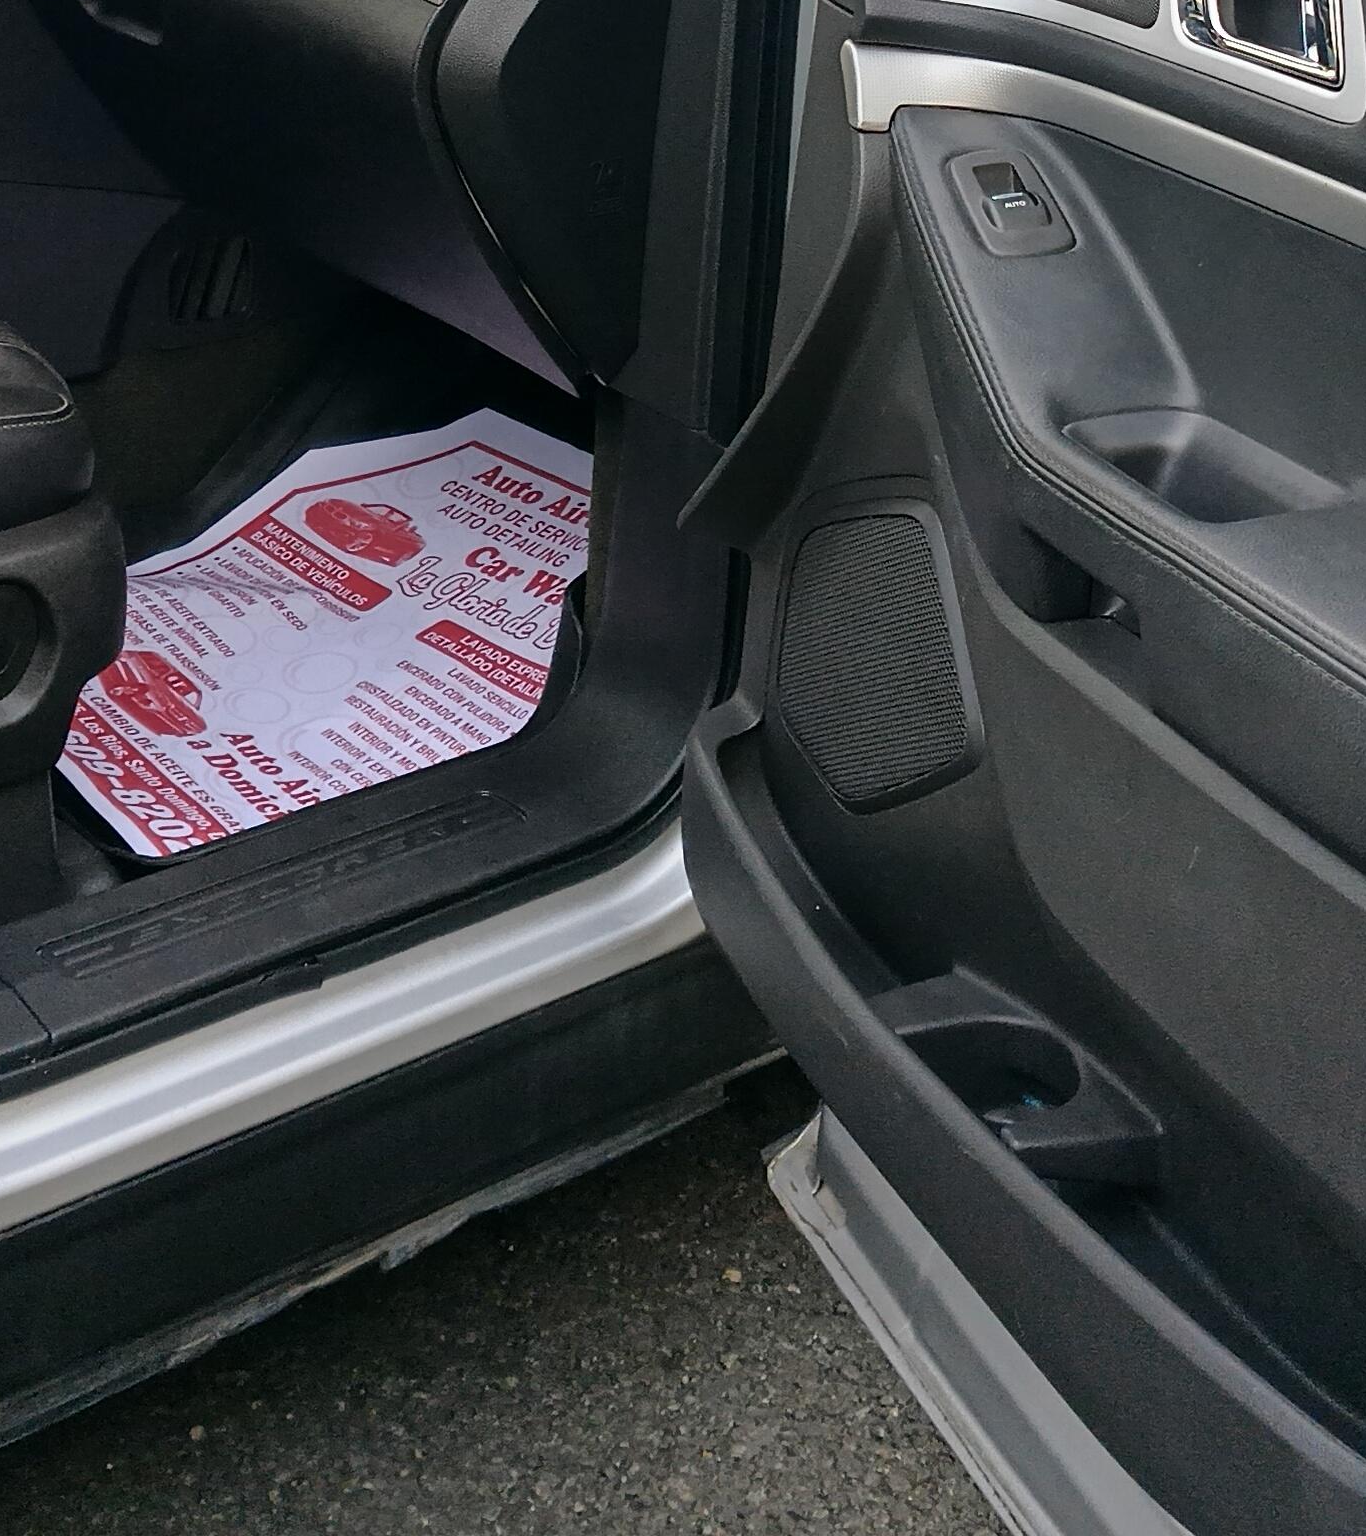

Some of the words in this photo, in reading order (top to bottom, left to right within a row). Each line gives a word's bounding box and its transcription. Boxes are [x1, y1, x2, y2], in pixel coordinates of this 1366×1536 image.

[440, 480, 507, 515] CENTRO
[502, 509, 533, 528] DE
[472, 465, 544, 505] Auto
[262, 522, 350, 580] MANTENIMIENTO
[437, 503, 487, 530] AUTO
[482, 524, 570, 568] DETAILING
[289, 556, 310, 572] DE
[306, 566, 369, 606] VEHÍCULOS
[465, 546, 525, 583] Car
[165, 598, 199, 622] ACEITE
[208, 590, 246, 618] GRAFITO
[270, 598, 288, 611] EN
[282, 610, 308, 631] SECO
[395, 556, 443, 598] La
[423, 572, 511, 628] Gloria
[501, 604, 548, 640] de
[126, 609, 158, 634] GRASA
[152, 633, 170, 645] DE
[135, 593, 153, 604] DE
[145, 604, 179, 628] ACEITE
[171, 627, 210, 659] NORMAL
[423, 631, 493, 672] DETALLADO
[460, 634, 510, 664] LAVADO
[396, 659, 447, 691] ENCERADO
[442, 687, 467, 704] CON
[461, 700, 511, 735] PULIDORA
[404, 685, 456, 721] ENCERADO
[450, 717, 463, 727] A
[459, 722, 492, 746] MANO
[447, 667, 487, 695] LAVADO
[482, 690, 529, 720] SENCILLO
[343, 694, 414, 743] RESTAURACIÓN
[355, 680, 421, 722] CRISTALIZADO
[415, 717, 435, 731] EN
[428, 726, 469, 755] PINTUR
[89, 696, 136, 737] CAMBIO
[134, 735, 160, 752] DE
[150, 752, 199, 789] ACEITE
[191, 789, 215, 804] ES
[210, 805, 244, 833] GRA
[186, 740, 212, 751] a
[219, 732, 284, 776] Auto
[320, 727, 367, 760] INTERIOR
[362, 756, 374, 765] Y
[347, 721, 394, 755] INTERIOR
[389, 750, 403, 760] Y
[397, 756, 420, 771] MO
[409, 737, 422, 748] Y
[415, 744, 441, 765] BRIL
[77, 716, 105, 734] Los
[124, 759, 163, 787] Santo
[155, 787, 212, 831] Domingo,
[287, 750, 333, 782] INTERIOR
[330, 758, 354, 774] CON
[350, 771, 373, 787] CER
